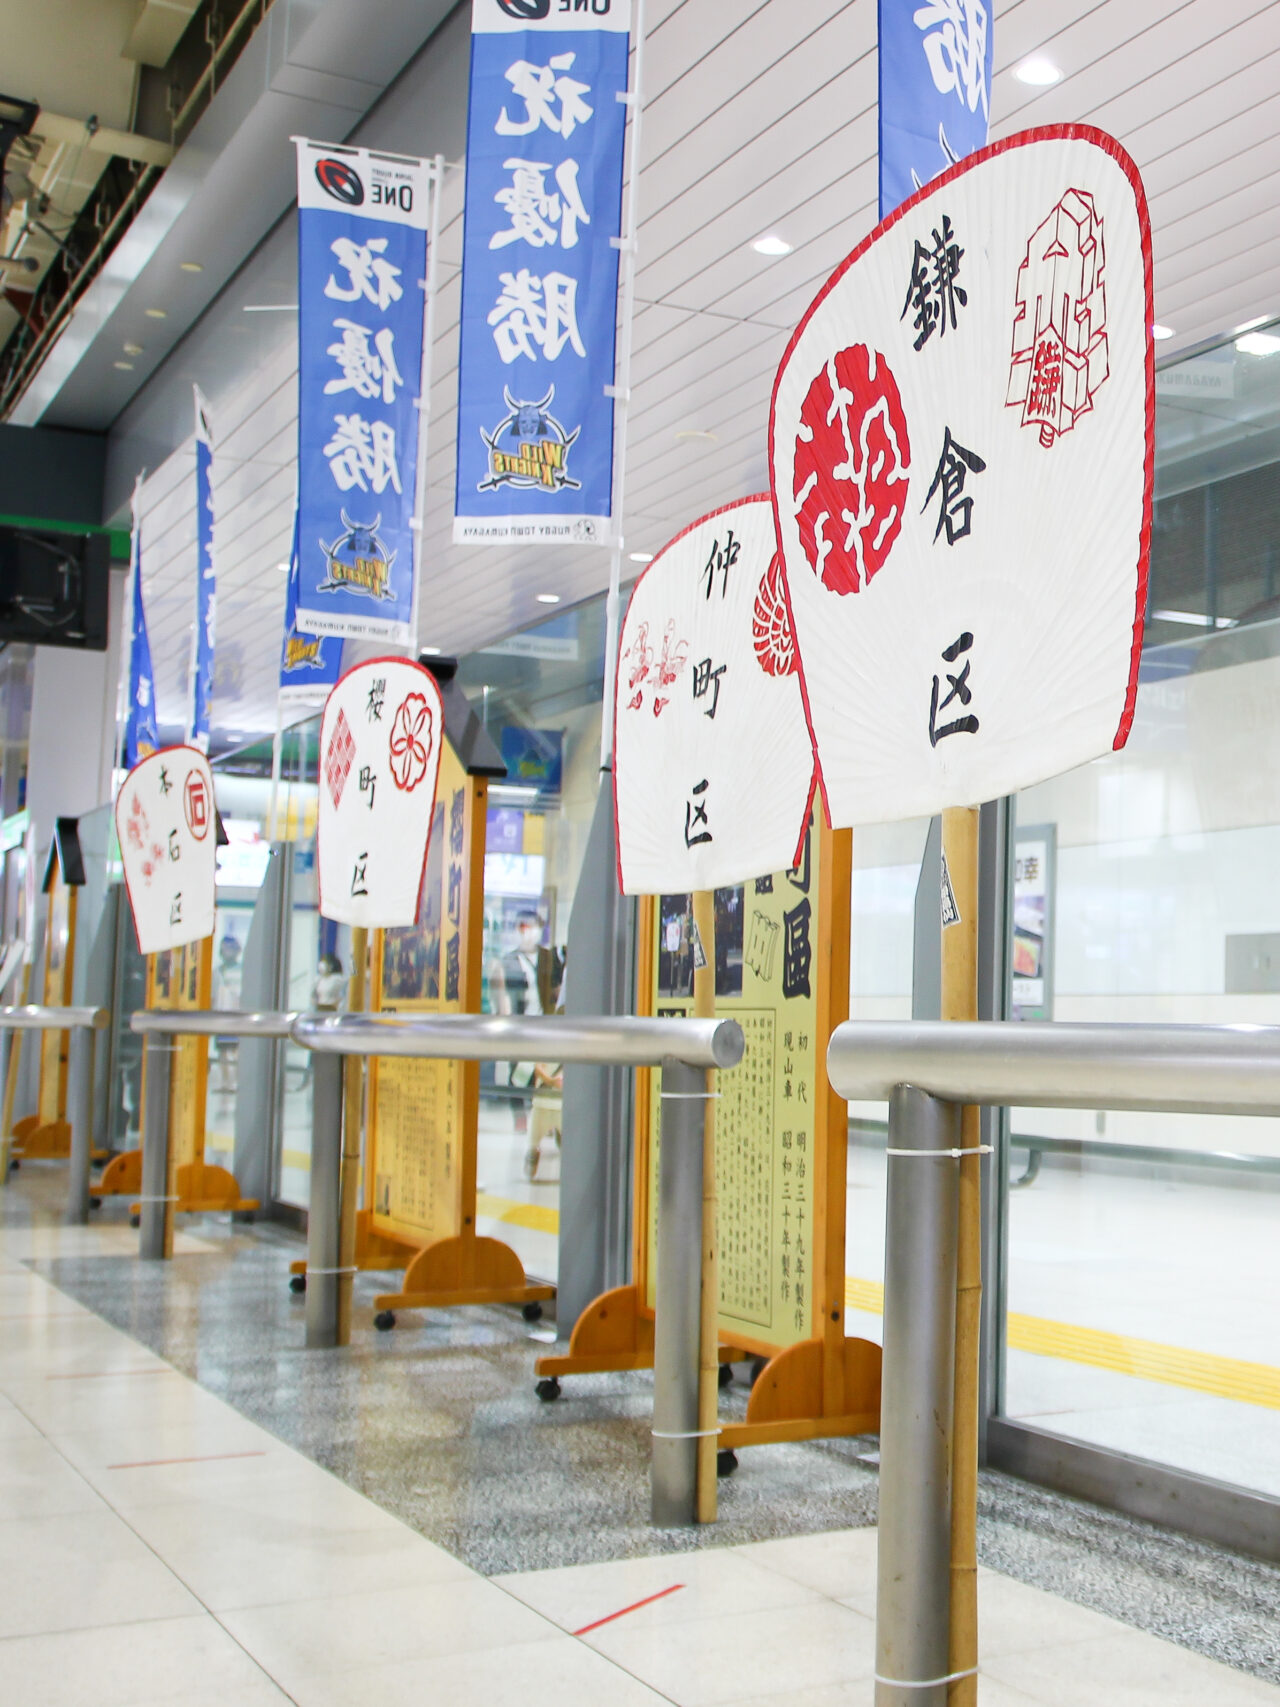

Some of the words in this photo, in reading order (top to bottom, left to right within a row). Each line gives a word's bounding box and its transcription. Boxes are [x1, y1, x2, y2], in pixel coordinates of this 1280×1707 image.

[685, 531, 741, 849] 仲町区
[901, 215, 986, 749] 鎌倉区
